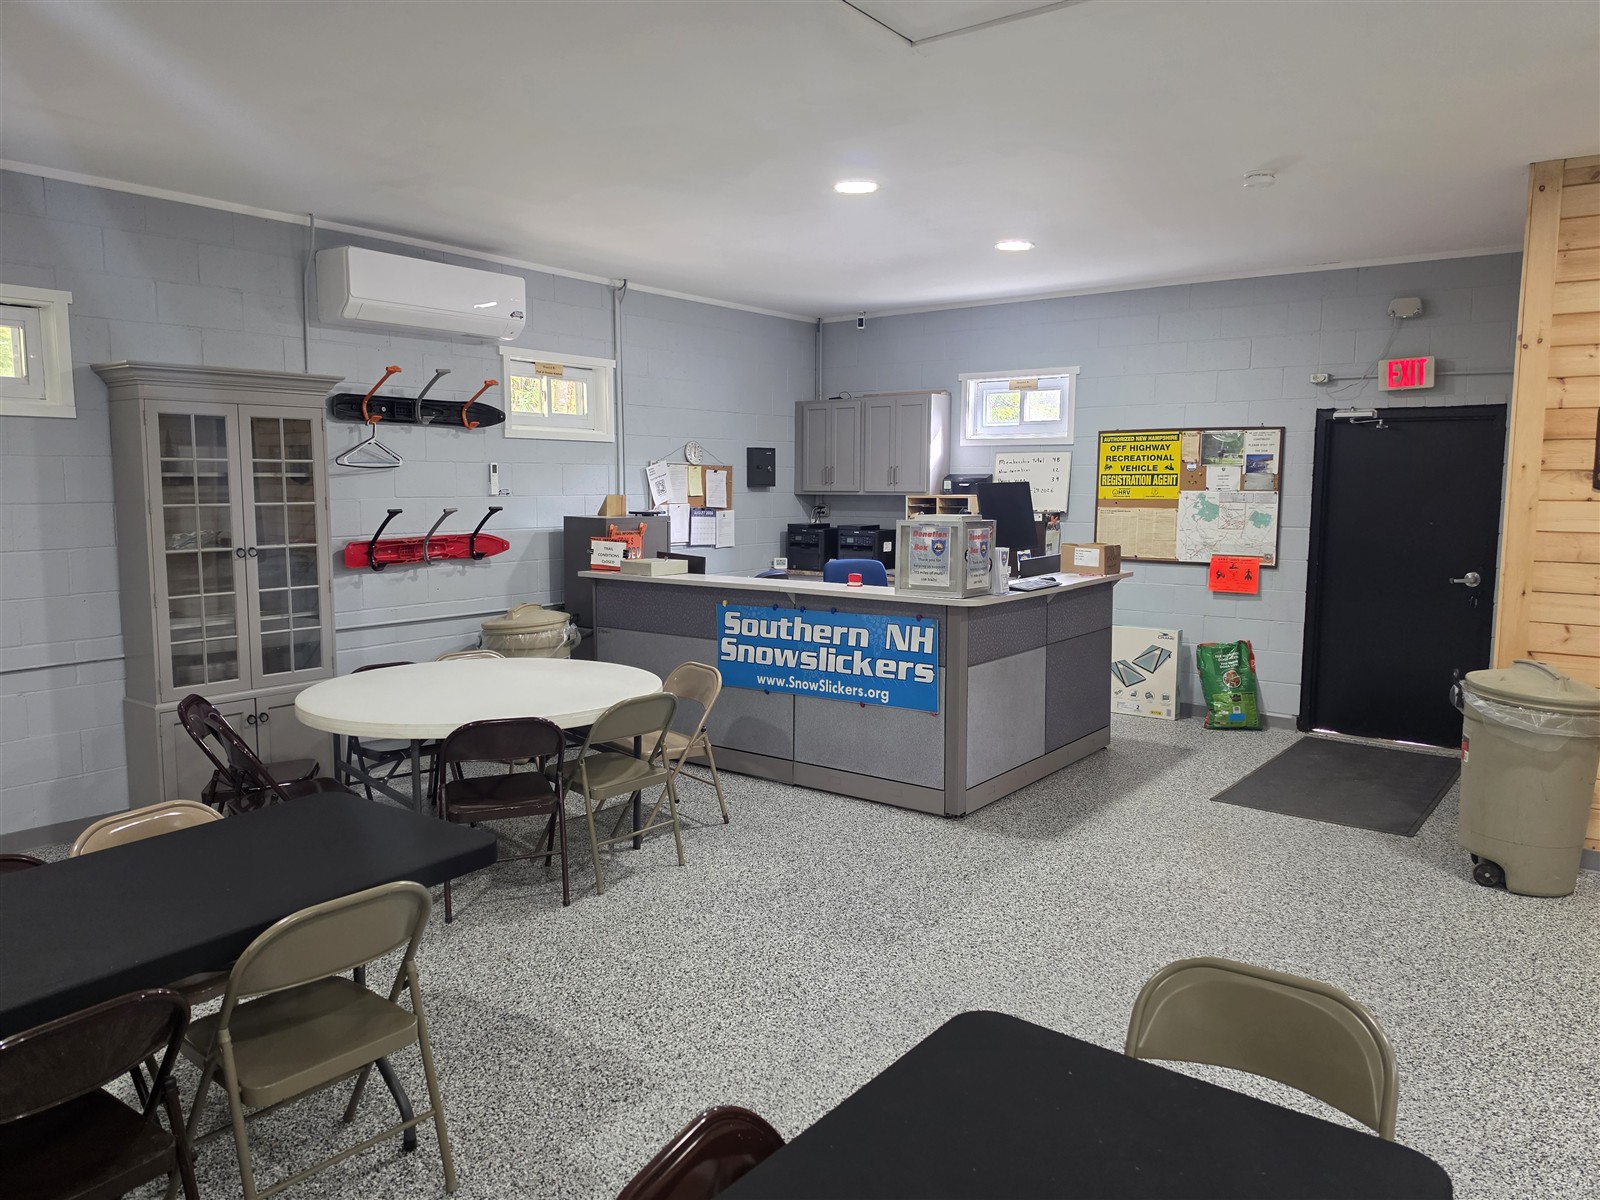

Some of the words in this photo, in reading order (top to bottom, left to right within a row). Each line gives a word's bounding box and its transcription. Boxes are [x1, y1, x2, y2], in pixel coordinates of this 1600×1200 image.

[1387, 357, 1428, 389] EXIT
[1129, 444, 1171, 452] HIGHWAY
[1105, 454, 1175, 462] RECREATIONAL
[1102, 474, 1152, 486] REGISTRATION
[1152, 474, 1178, 486] AGENT
[912, 530, 948, 538] Donation
[913, 543, 929, 551] Box
[724, 611, 870, 648] Southern
[885, 623, 935, 655] NH
[720, 637, 935, 684] Snowslickers
[756, 674, 889, 703] www.SnowSlickers.org
